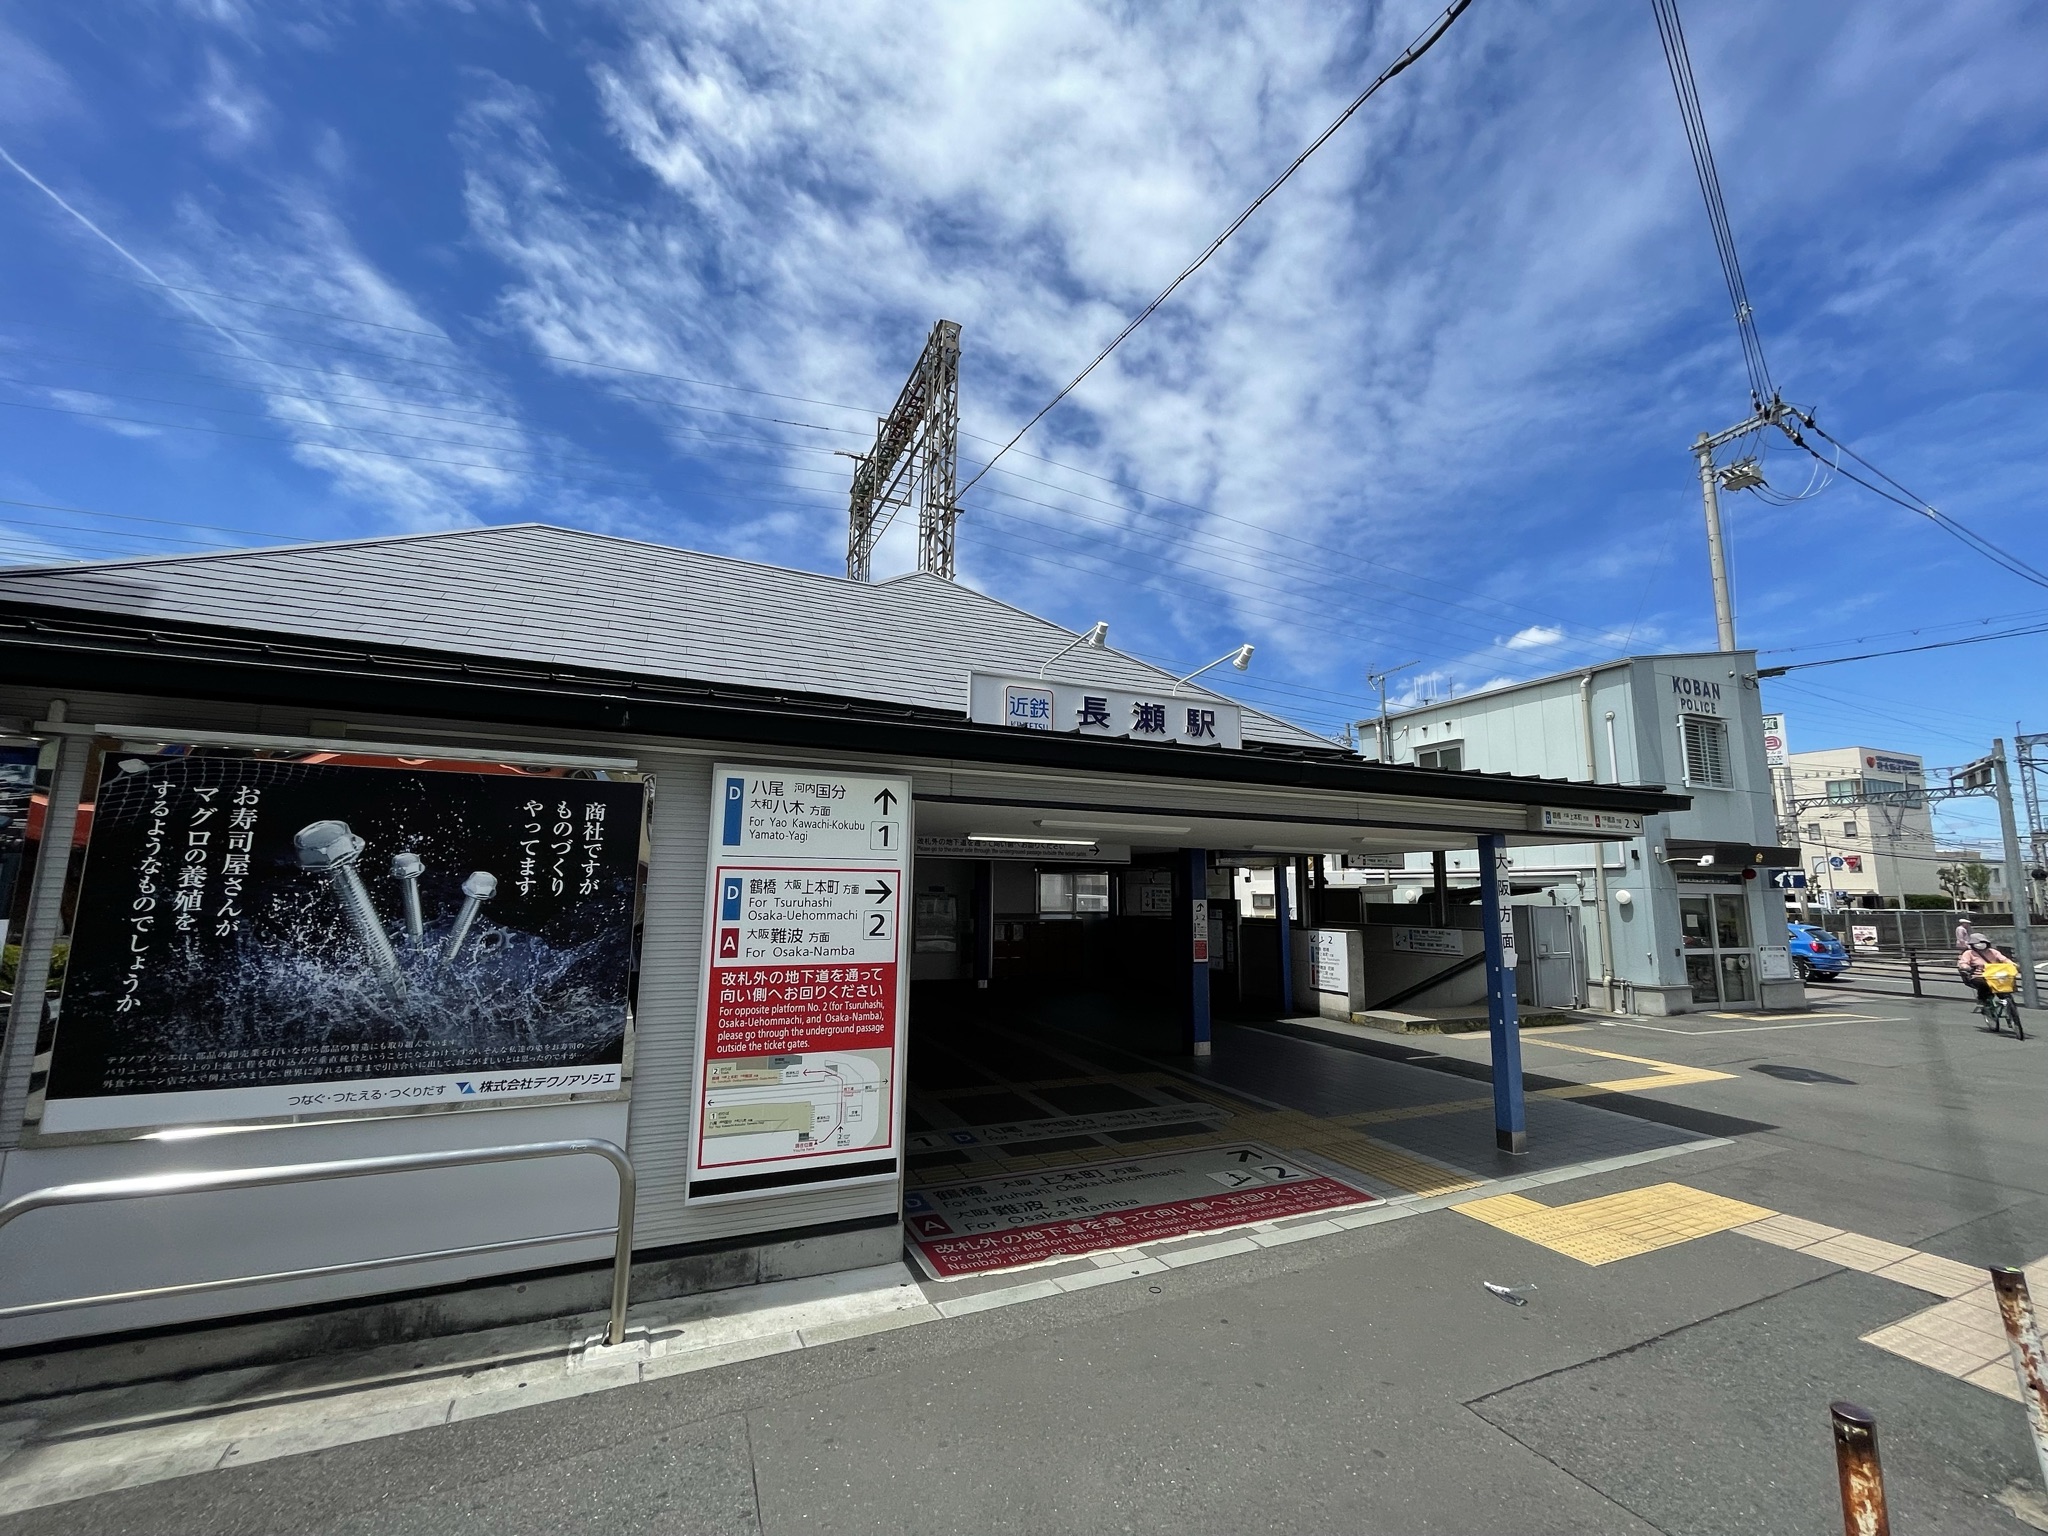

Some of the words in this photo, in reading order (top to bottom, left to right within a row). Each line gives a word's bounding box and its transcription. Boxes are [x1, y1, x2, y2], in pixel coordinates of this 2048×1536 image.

[1671, 676, 1720, 700] KOBAN
[1010, 696, 1049, 719] 近鉄
[1680, 698, 1716, 714] POLICE
[1076, 696, 1216, 738] 長瀬駅
[729, 786, 741, 800] D
[751, 781, 784, 797] 八尾
[794, 783, 846, 799] 河内国分
[750, 799, 804, 815] 大和八木
[809, 806, 831, 816] 方面
[749, 817, 764, 827] For
[770, 817, 787, 828] Yao
[792, 818, 865, 831] Kawachi-Kokubu
[1624, 818, 1630, 829] 2
[749, 830, 808, 843] Yamato-Yagi
[878, 825, 889, 846] 1
[515, 799, 544, 896] やってます
[551, 800, 573, 897] ものづくり
[579, 802, 607, 895] 商社ですが
[172, 786, 219, 931] マグロの養殖を
[215, 785, 261, 937] お寿司屋さんが
[727, 886, 739, 899] D
[749, 878, 777, 895] 鶴橋
[784, 880, 840, 895] 大阪上本町
[843, 884, 860, 895] 方面
[116, 780, 177, 1012] するようなものでしょうか
[749, 898, 768, 907] For
[774, 897, 832, 907] Tsuruhashi
[1495, 853, 1513, 949] 大阪方面
[748, 909, 858, 921] Osaka-Uehommachi
[869, 914, 885, 936] 2
[723, 939, 736, 950] A
[747, 928, 803, 944] 大阪難波
[808, 932, 830, 943] 方面
[746, 947, 765, 957] For
[773, 946, 855, 957] Osaka-Namba
[721, 968, 883, 986] 改札外の地下道を通って
[720, 984, 883, 1003] 向い側へお回りください
[719, 1006, 733, 1016] For
[735, 1005, 769, 1017] opposite
[771, 1003, 805, 1016] platform
[807, 1003, 821, 1012] No.
[823, 1002, 828, 1011] 2
[829, 1001, 843, 1011] (for
[844, 999, 885, 1010] Tsuruhashi,
[718, 1015, 804, 1029] Osaka-Uehommachi,
[806, 1013, 821, 1024] and
[825, 1011, 884, 1023] Osaka-Namba),
[717, 1030, 743, 1043] please
[745, 1031, 756, 1042] go
[758, 1027, 789, 1040] through
[791, 1026, 804, 1036] the
[806, 1023, 854, 1037] underground
[856, 1024, 885, 1035] passage
[716, 1042, 747, 1053] outside
[748, 1041, 762, 1051] the
[764, 1039, 785, 1050] ticket
[787, 1039, 810, 1051] gates.
[478, 1073, 615, 1093] 株式会社テクノアソシエ
[913, 1137, 933, 1146] 1
[999, 1169, 1106, 1188] 大阪上本町
[1108, 1166, 1143, 1175] 方面
[1261, 1166, 1300, 1179] 2
[942, 1200, 967, 1208] For
[975, 1187, 1051, 1203] Tsuruhashi
[1056, 1168, 1186, 1191] Osaka-Uehommachi
[1053, 1196, 1089, 1207] 方面
[933, 1182, 1336, 1254] 改札外の地下道を通って向い側へお回りください
[964, 1221, 997, 1231] For
[1008, 1199, 1140, 1224] Osaka-Namba
[924, 1220, 945, 1232] A
[941, 1255, 962, 1263] For
[966, 1244, 1020, 1260] opposite
[1023, 1235, 1076, 1252] platform
[947, 1256, 1007, 1271] Namba),
[1009, 1249, 1048, 1263] please
[1050, 1247, 1067, 1255] go
[1068, 1238, 1116, 1251] through
[1116, 1233, 1138, 1241] the
[1139, 1221, 1209, 1238] underground
